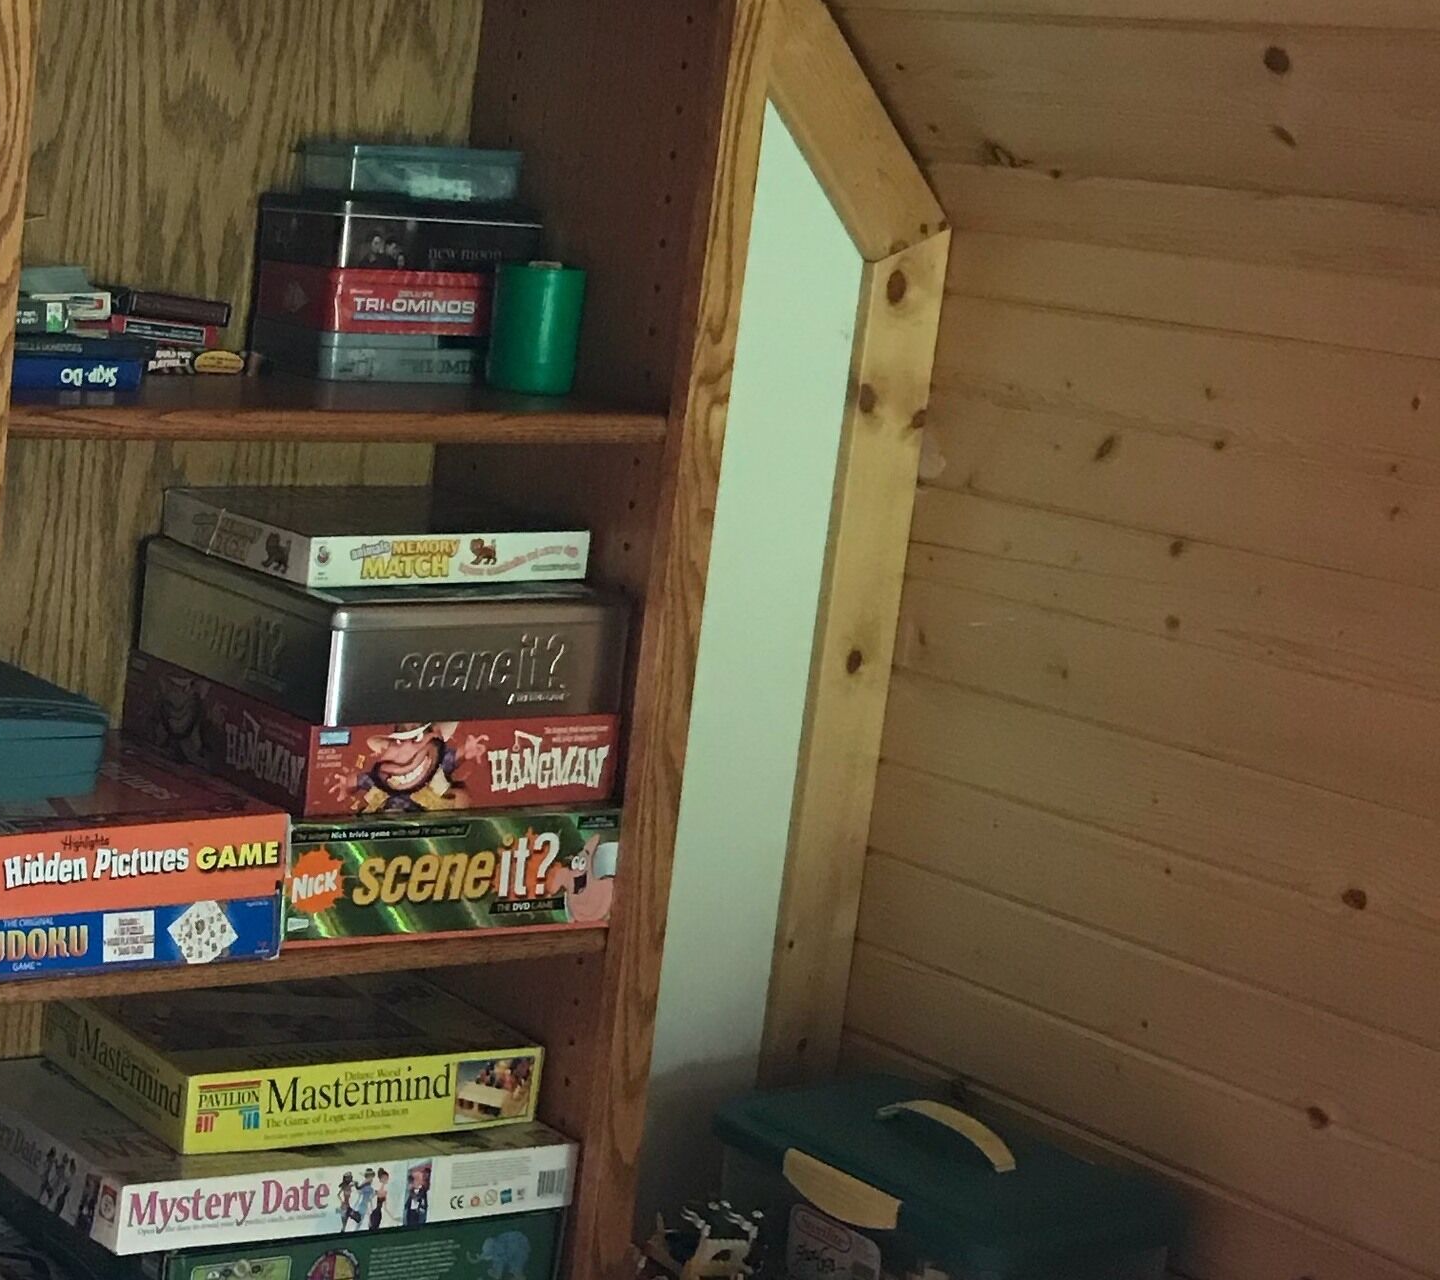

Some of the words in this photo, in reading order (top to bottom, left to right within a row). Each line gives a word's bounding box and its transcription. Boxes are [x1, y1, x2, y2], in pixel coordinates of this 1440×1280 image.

[428, 247, 457, 259] new
[390, 538, 459, 558] MEMORY
[359, 554, 450, 580] MATCH
[487, 736, 610, 793] HANGMAN
[331, 830, 348, 840] Nick
[3, 851, 87, 889] Hidden
[92, 846, 190, 880] Pictures
[195, 840, 280, 871] GAME
[351, 850, 496, 905] scene
[496, 831, 560, 898] it?
[291, 869, 338, 904] NICK
[512, 900, 530, 911] DVD
[11, 961, 36, 972] GAME
[79, 1018, 183, 1119] Mastermind
[197, 1088, 260, 1109] PAVILION
[266, 1064, 452, 1115] Mastermind
[265, 1117, 282, 1129] The
[283, 1115, 309, 1127] Game
[322, 1112, 346, 1125] Logic
[347, 1110, 364, 1121] and
[126, 1177, 256, 1233] Mystery
[261, 1176, 331, 1215] Date
